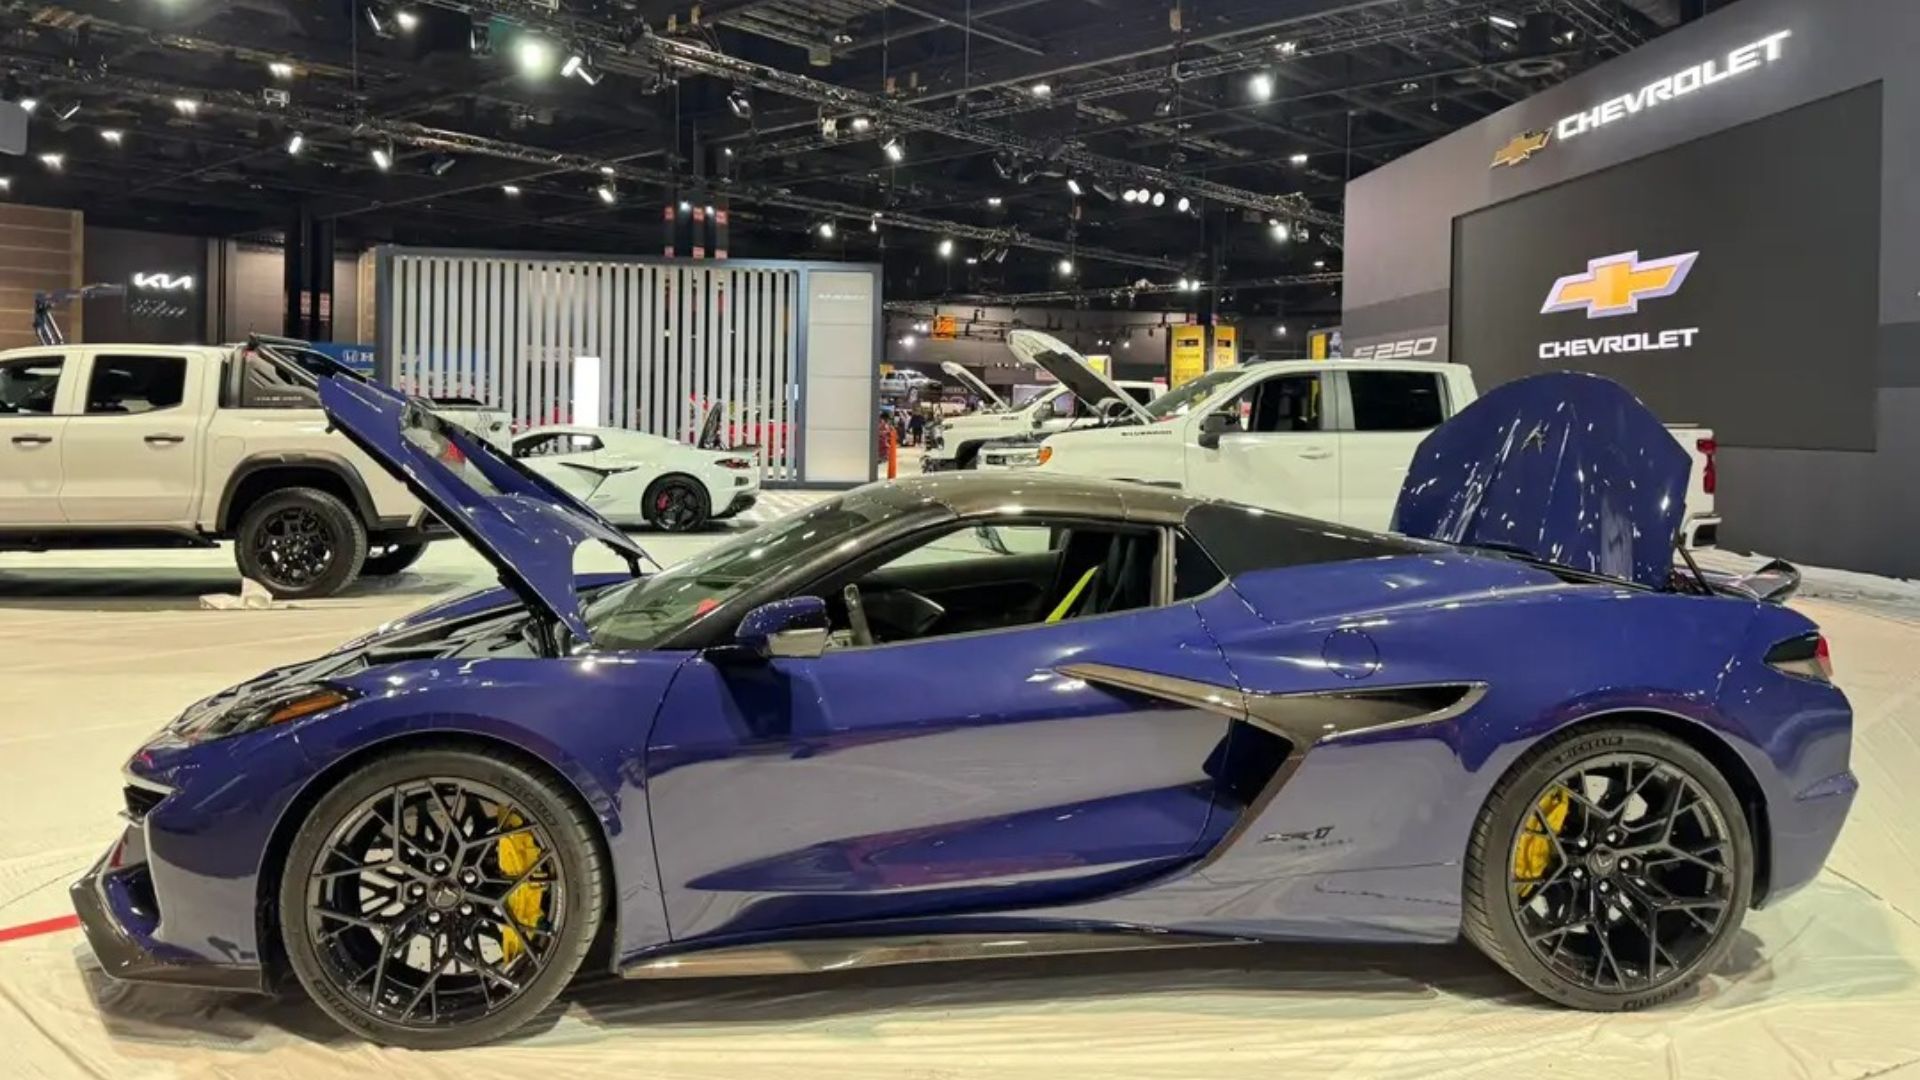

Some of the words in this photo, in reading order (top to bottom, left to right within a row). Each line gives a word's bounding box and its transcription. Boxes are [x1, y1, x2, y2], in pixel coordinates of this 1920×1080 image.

[1557, 30, 1791, 139] CHEVROLET
[134, 272, 193, 290] KIA
[1539, 327, 1699, 359] CHEVROLET
